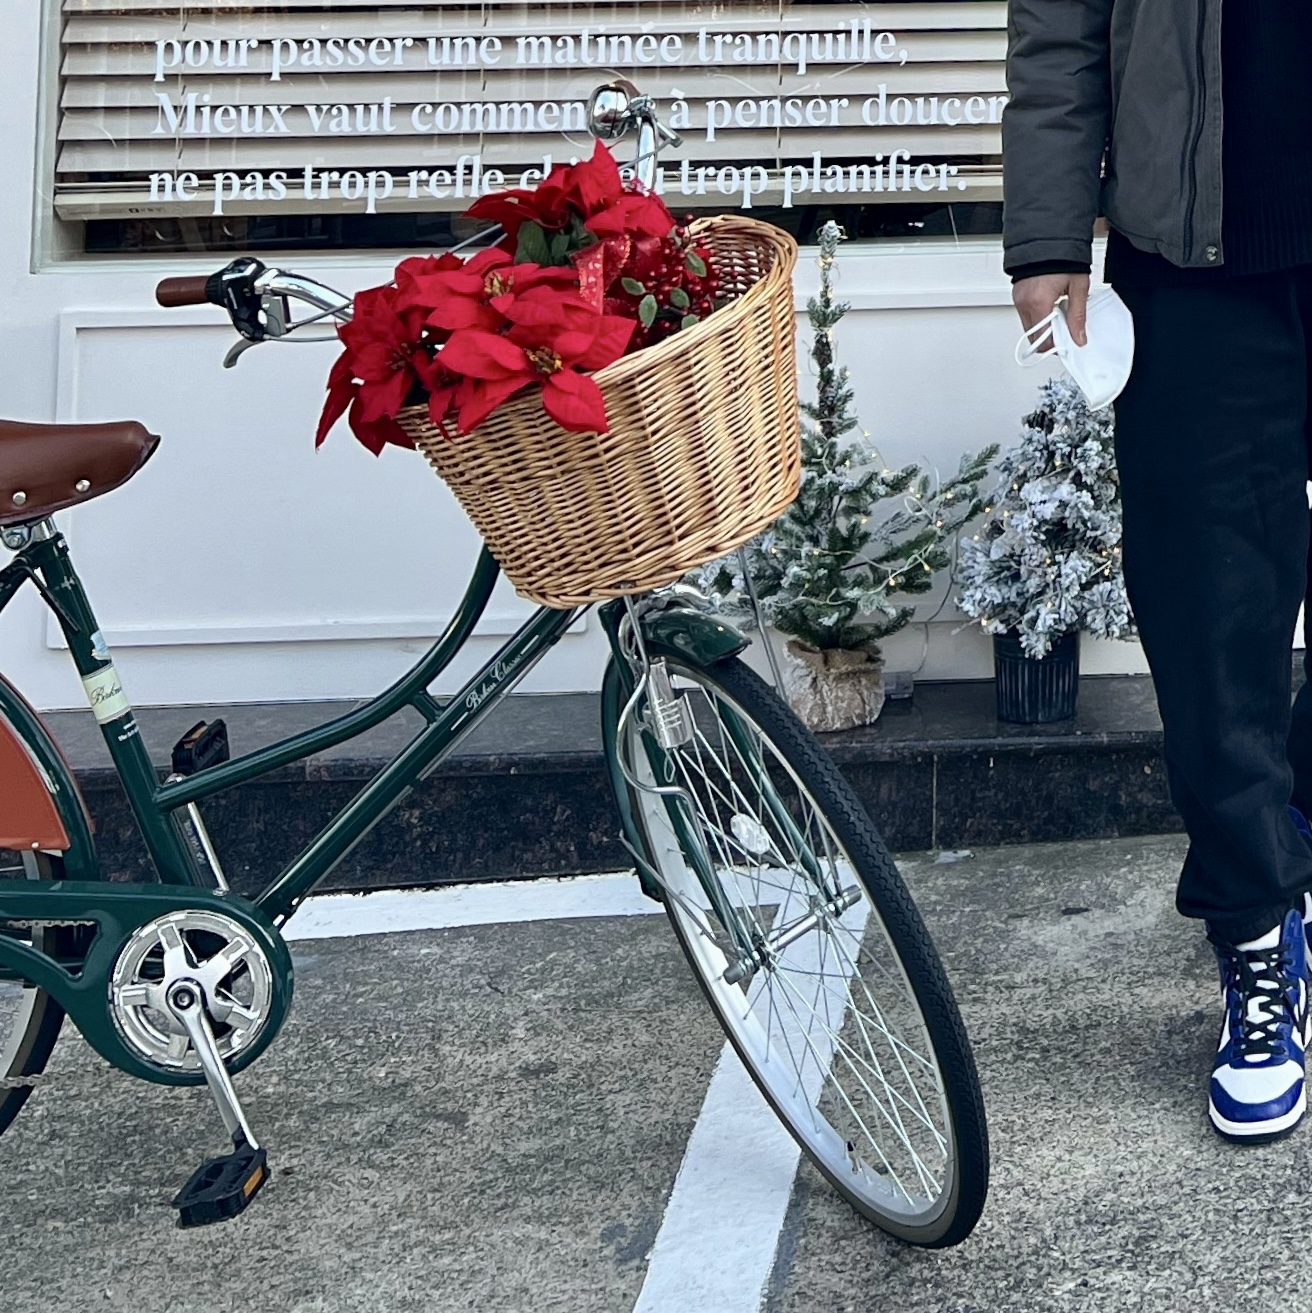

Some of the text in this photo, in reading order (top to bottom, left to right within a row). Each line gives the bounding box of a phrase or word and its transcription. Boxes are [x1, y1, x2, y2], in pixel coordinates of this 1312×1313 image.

[153, 18, 909, 82] pour passer une matinée tranquille,
[151, 91, 292, 135] Mieux
[304, 96, 397, 134] vaut
[669, 87, 692, 130] à
[705, 94, 849, 142] penser
[148, 170, 199, 202] ne
[211, 168, 288, 216] pas
[302, 163, 394, 214] trop
[680, 159, 769, 209] trop
[781, 149, 968, 209] planifier.
